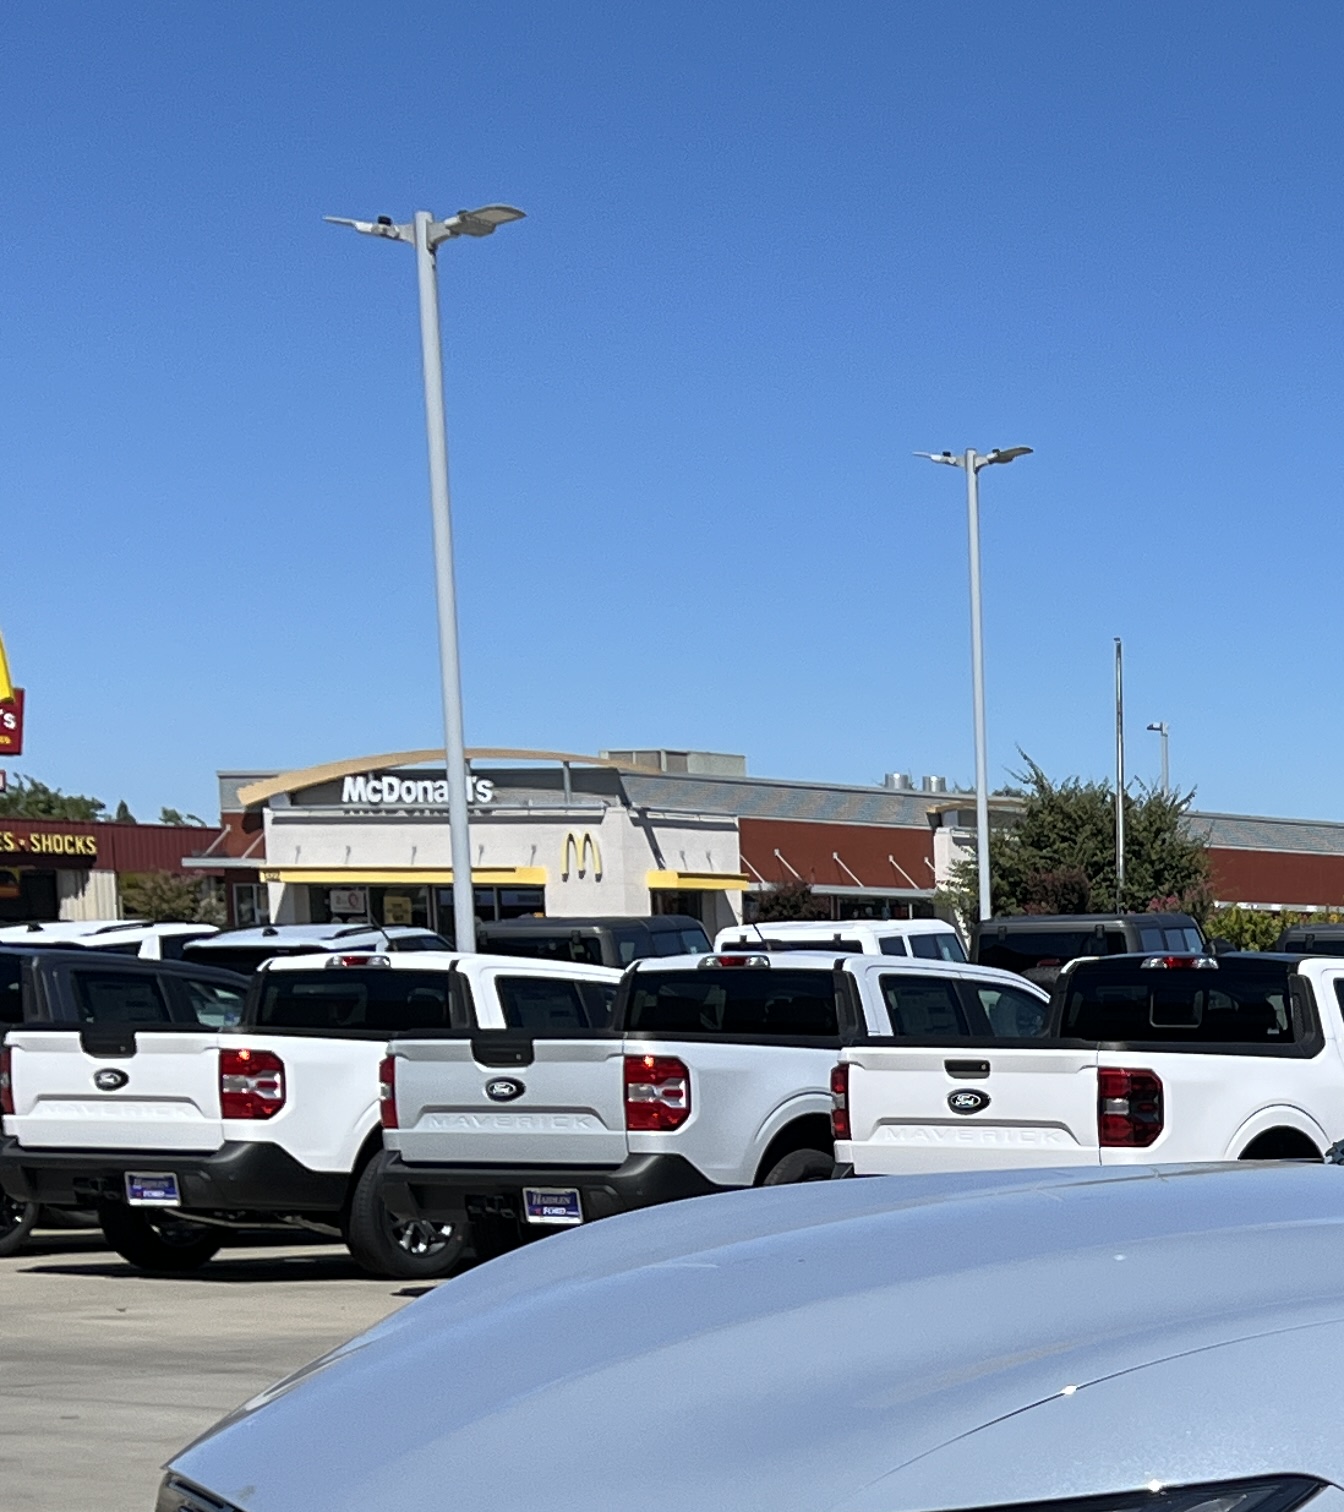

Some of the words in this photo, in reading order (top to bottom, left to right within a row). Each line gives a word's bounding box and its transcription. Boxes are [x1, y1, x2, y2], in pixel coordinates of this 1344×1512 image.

[342, 775, 494, 803] McDona's
[30, 833, 97, 855] SHOCKS
[429, 1115, 591, 1130] MAVERICK
[884, 1126, 1063, 1145] MAVERICK
